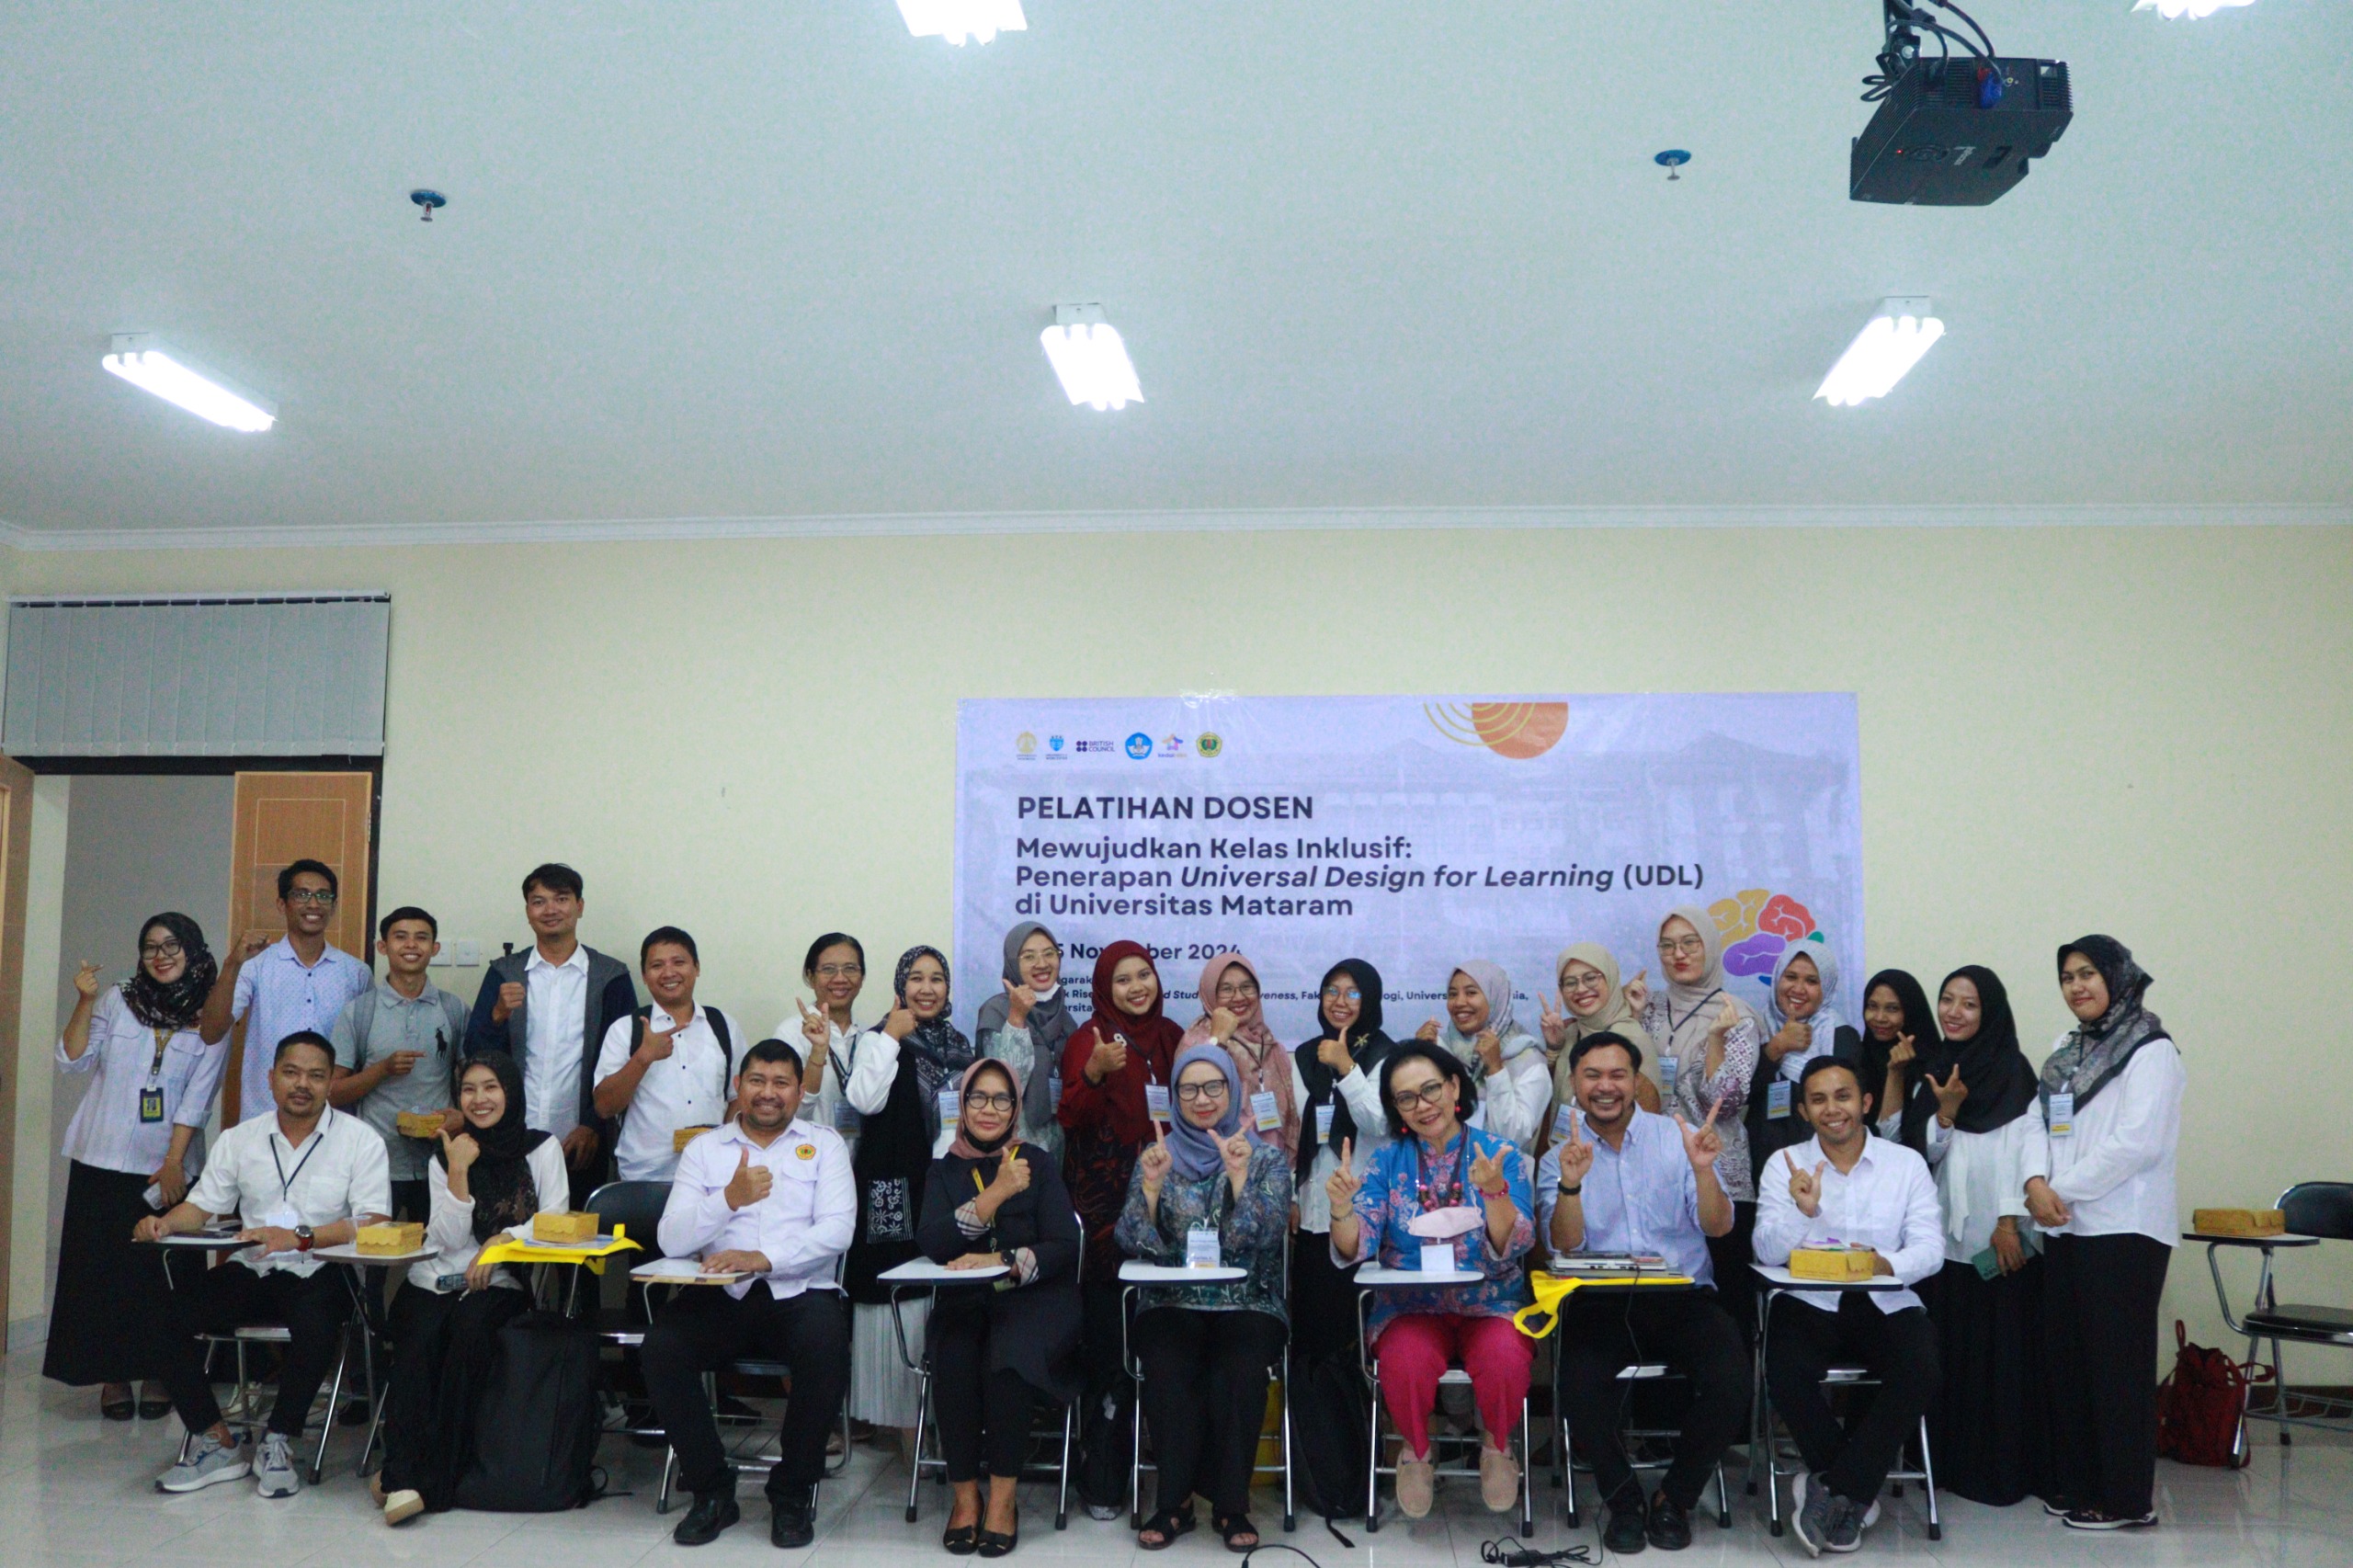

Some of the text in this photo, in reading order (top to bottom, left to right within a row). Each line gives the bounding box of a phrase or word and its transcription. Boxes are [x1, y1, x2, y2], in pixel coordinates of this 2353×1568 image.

[1017, 796, 1313, 820] PELATIHAN DOSEN
[1017, 835, 1412, 865] Mewujudkan Kelas Inklusif:
[1017, 864, 1704, 893] Penerapan Universal Design for Learning (UDL)
[1015, 892, 1353, 916] di Universitas Mataram
[1071, 943, 1183, 960] Nober
[1072, 990, 1093, 998] Rise
[1406, 991, 1449, 1000] Univers
